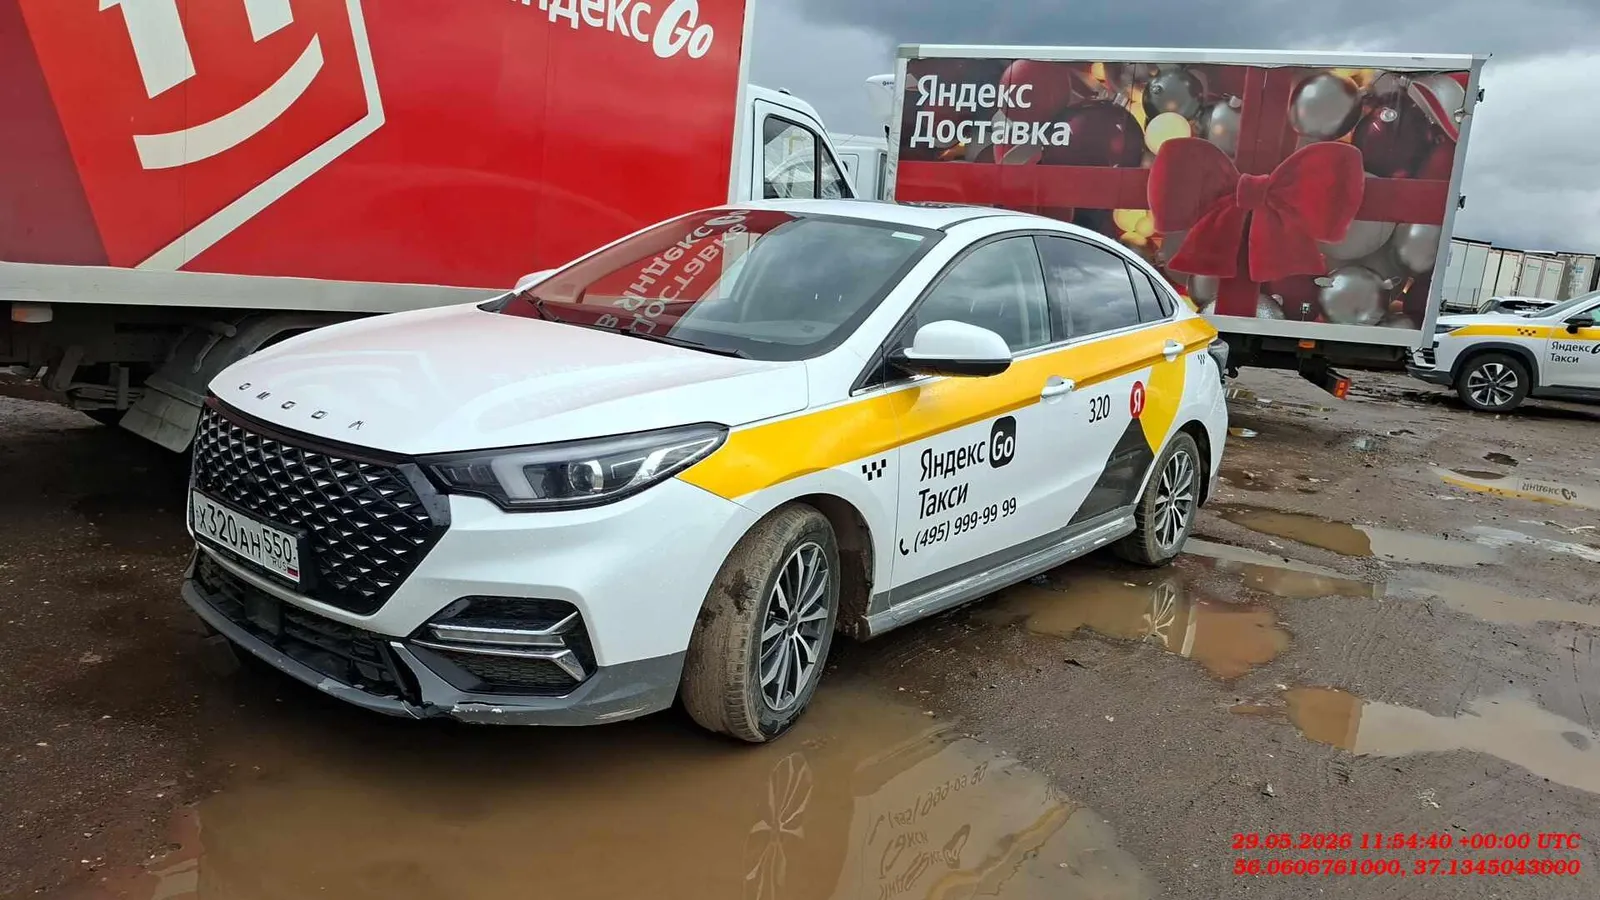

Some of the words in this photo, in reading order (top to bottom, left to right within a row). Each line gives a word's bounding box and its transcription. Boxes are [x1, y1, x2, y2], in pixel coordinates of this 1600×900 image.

[509, 0, 651, 43] декс
[653, 0, 714, 58] Go
[916, 74, 1033, 112] Яндекс
[909, 111, 1071, 149] Доставка
[1550, 353, 1579, 363] Такси
[1551, 341, 1591, 353] Яндекс
[1088, 394, 1111, 424] 320
[1132, 388, 1142, 414] Я
[919, 441, 986, 482] Яндекс
[991, 431, 1015, 461] Go
[918, 482, 969, 520] Такси
[914, 520, 951, 553] (495)
[953, 504, 998, 536] 999-99
[1002, 497, 1017, 518] 99
